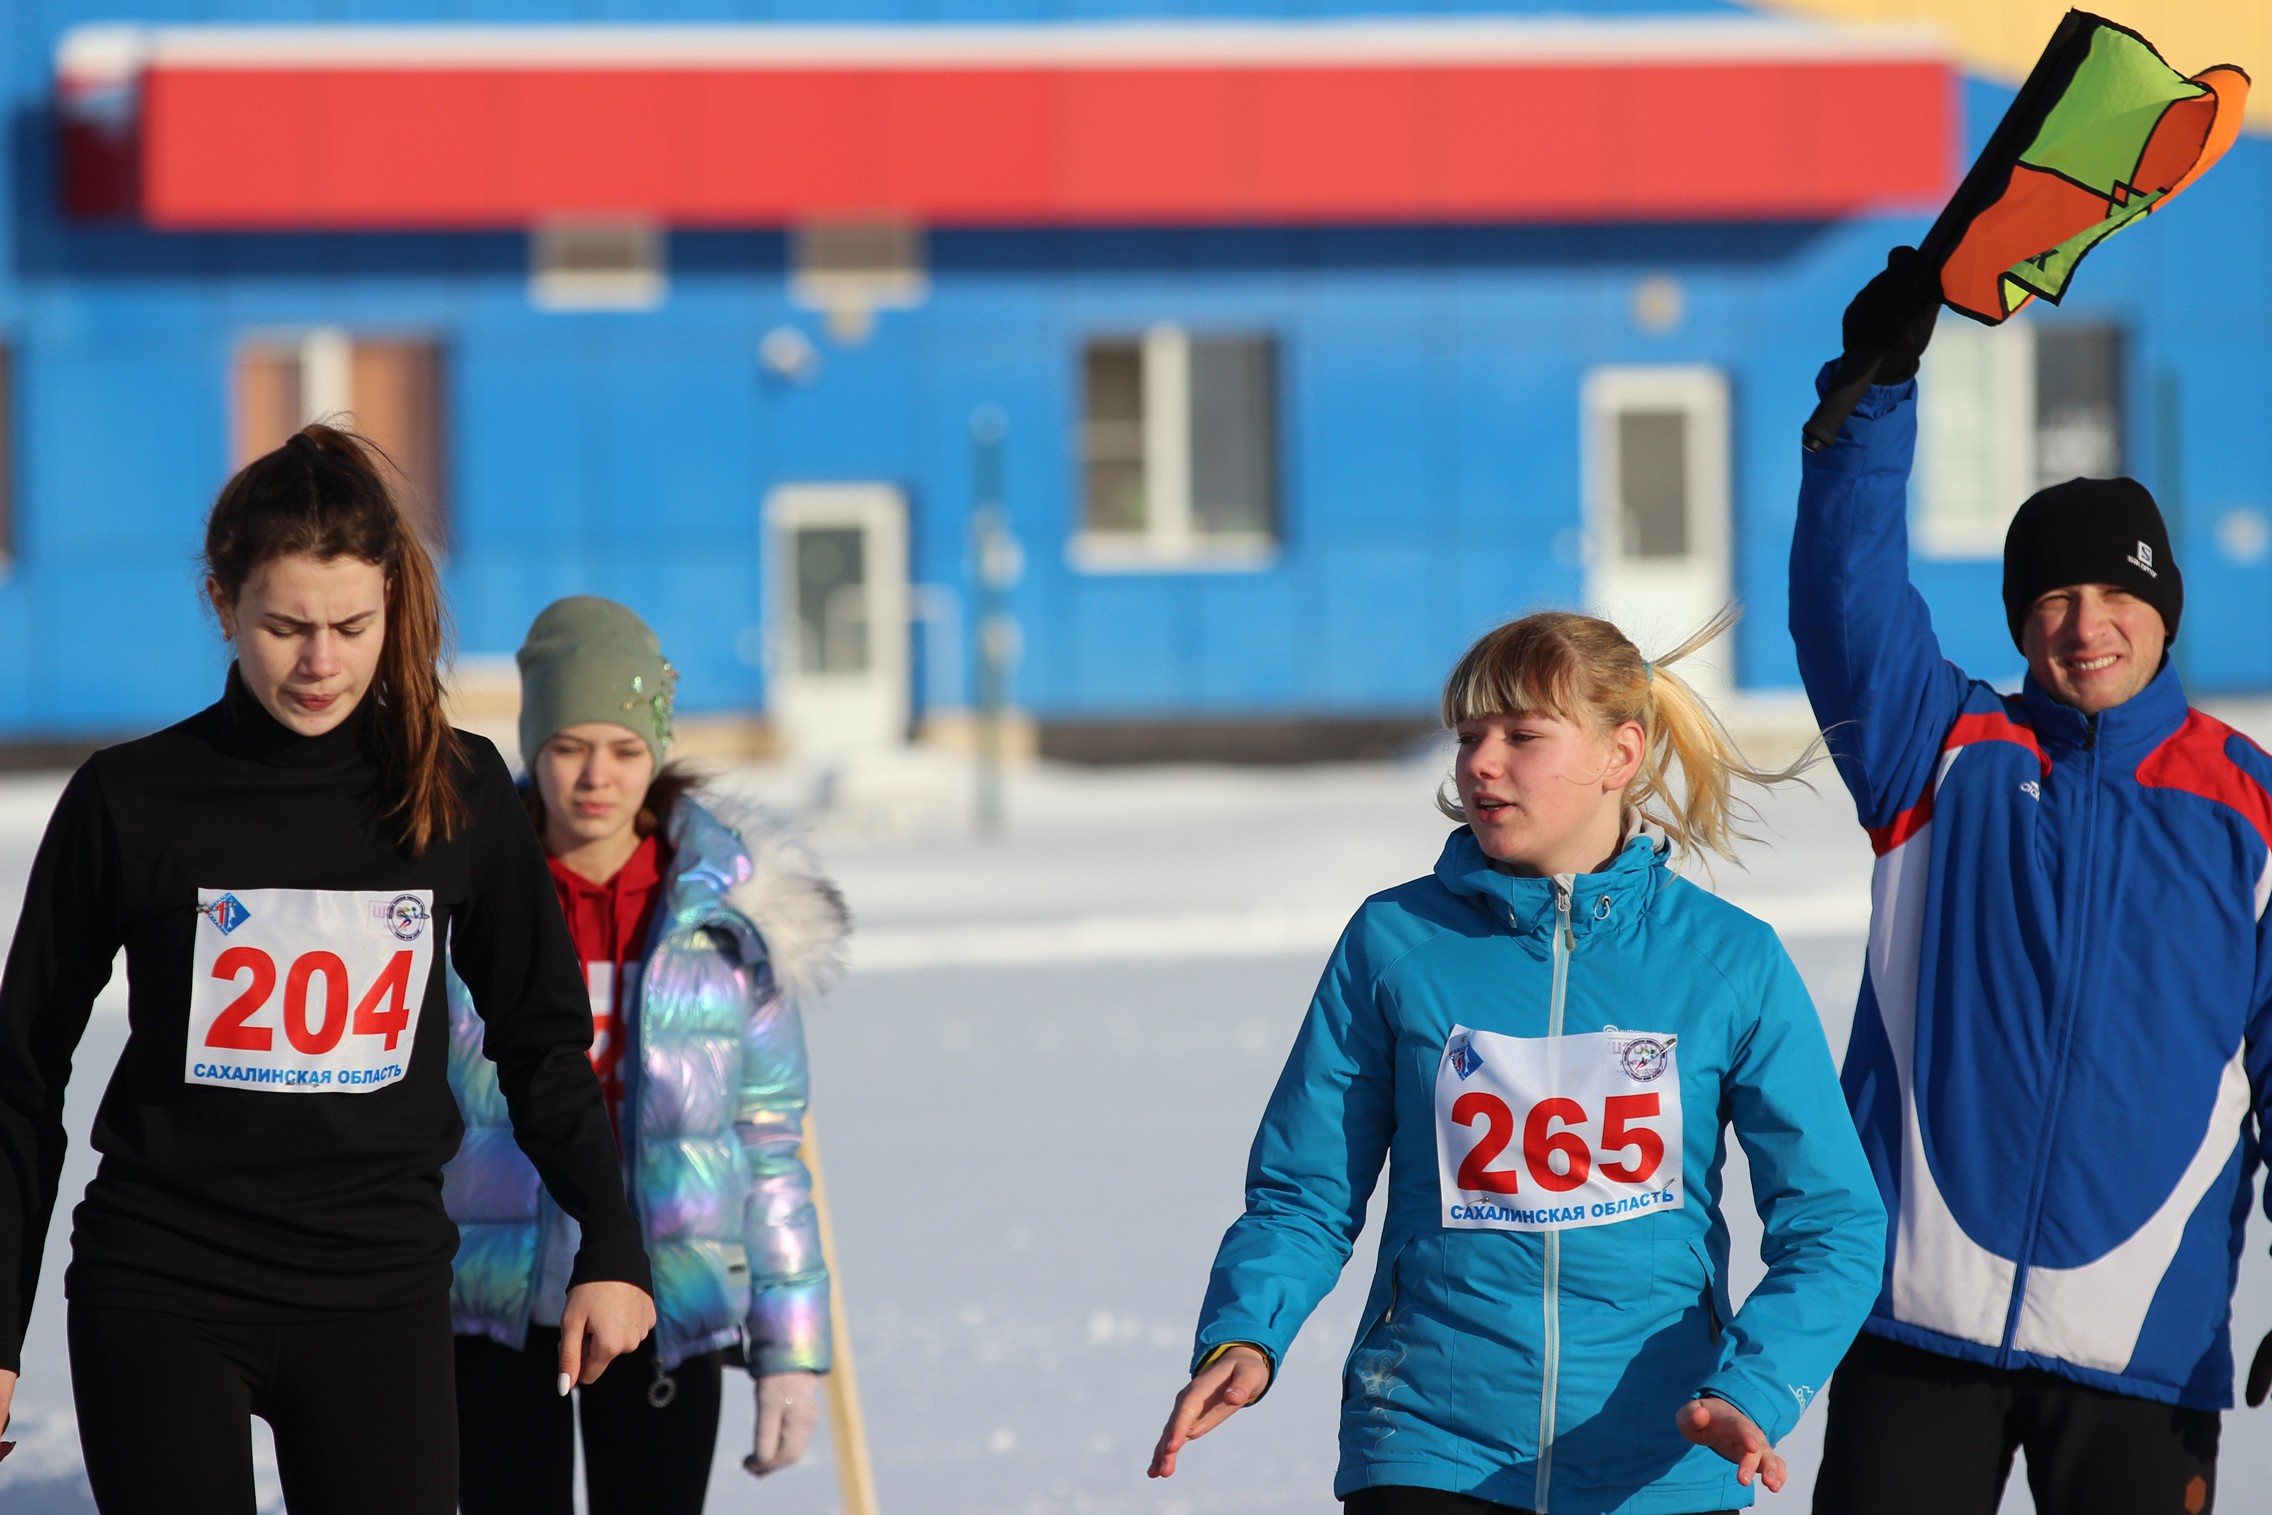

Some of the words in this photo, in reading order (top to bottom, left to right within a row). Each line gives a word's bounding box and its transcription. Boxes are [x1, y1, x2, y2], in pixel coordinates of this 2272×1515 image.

[204, 946, 413, 1055] 204
[193, 1063, 332, 1084] САХАЛИНСКАЯ
[337, 1063, 402, 1085] ОБЛАСТЬ
[1452, 1092, 1664, 1195] 265
[1450, 1204, 1585, 1224] САХАЛИНСКАЯ
[1591, 1189, 1674, 1218] ОБЛАСТЬ
